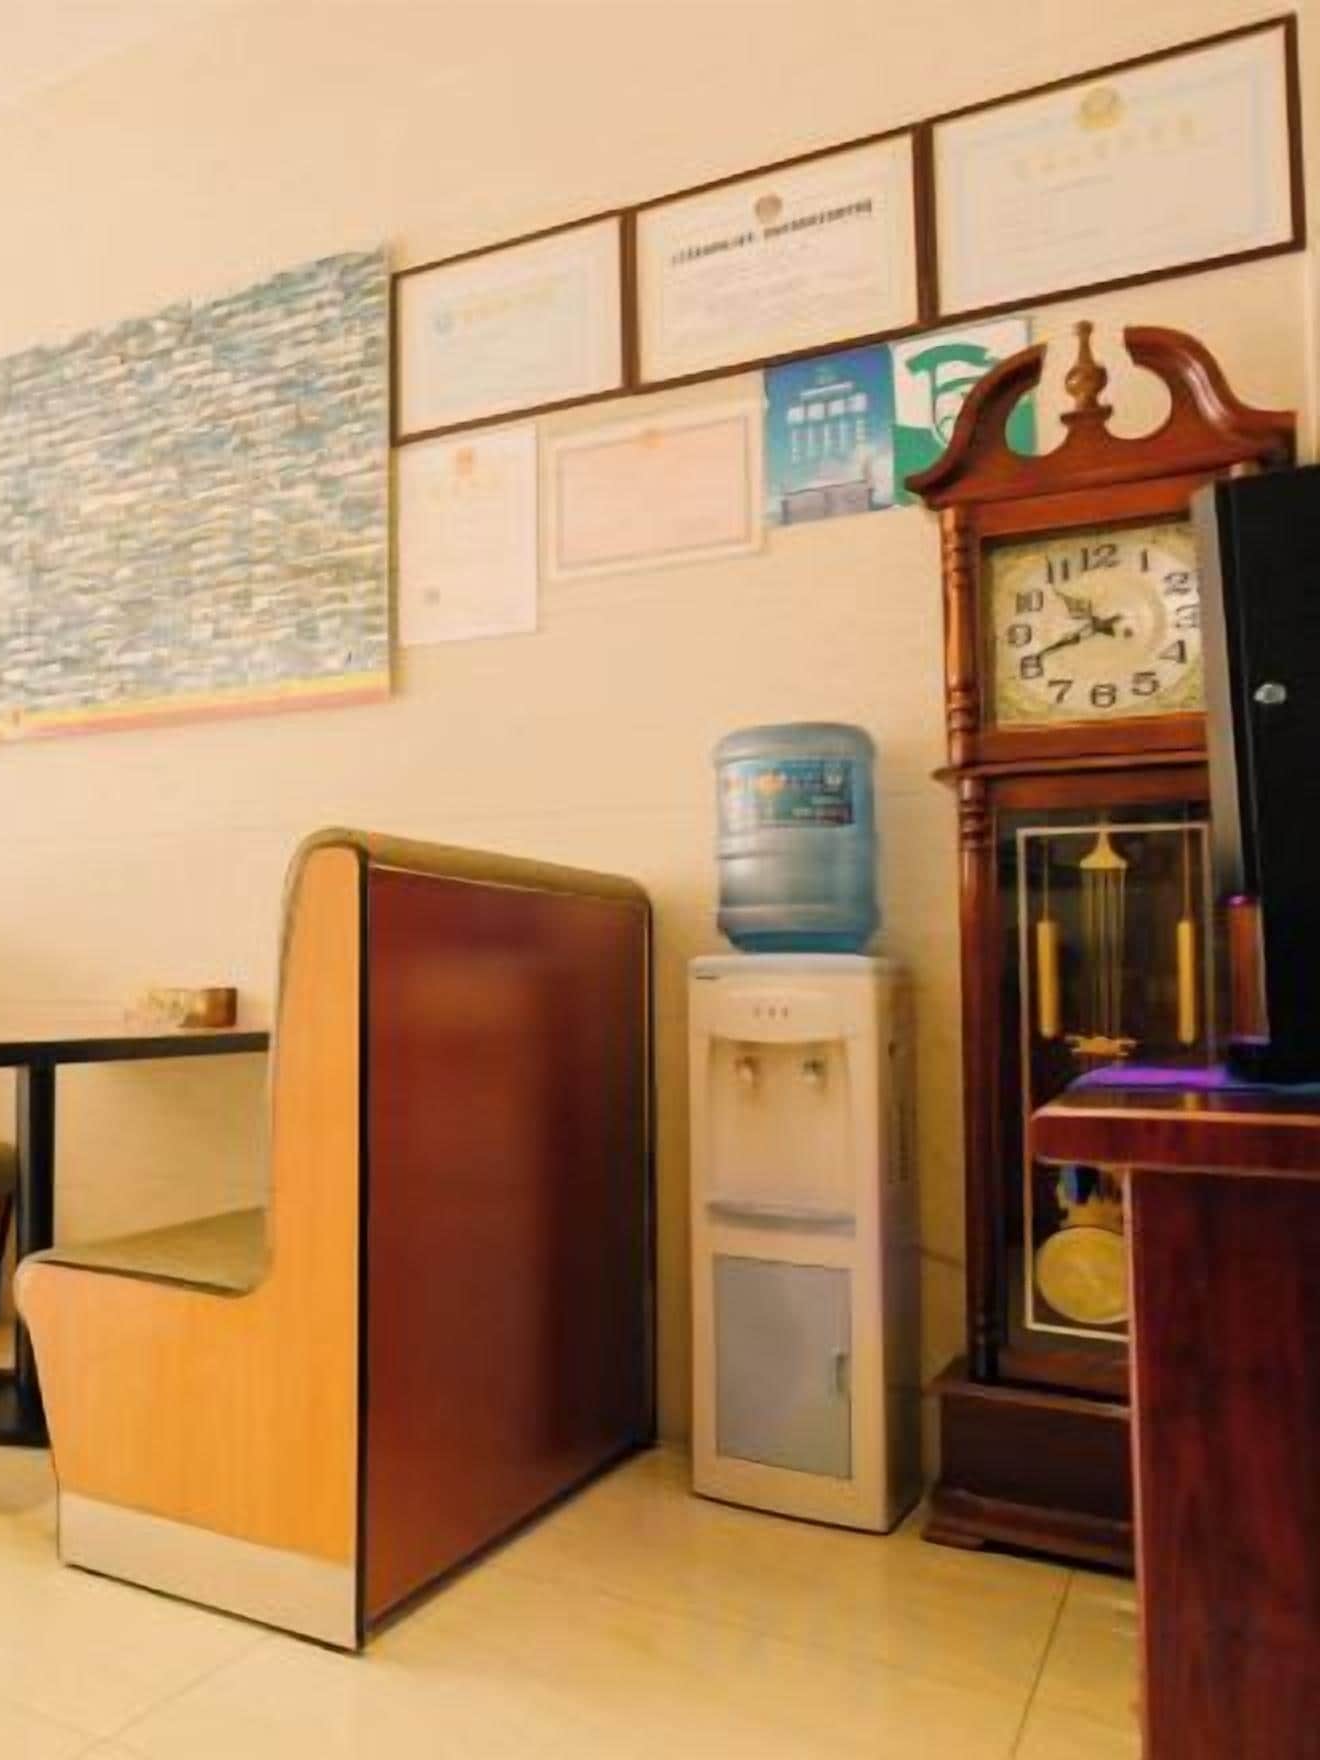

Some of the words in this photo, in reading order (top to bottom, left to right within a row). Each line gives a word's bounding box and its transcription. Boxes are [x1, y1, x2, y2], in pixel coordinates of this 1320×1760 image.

[1081, 544, 1119, 572] 12
[1140, 549, 1149, 573] 1
[1046, 558, 1070, 585] 11
[1164, 572, 1189, 595] 2
[1015, 590, 1045, 614] 10
[1175, 603, 1200, 629] 3
[1007, 623, 1033, 648] 9
[1159, 639, 1188, 664] 4
[1020, 655, 1044, 680] 8
[1047, 679, 1075, 704] 7
[1089, 683, 1118, 709] 6
[1132, 671, 1160, 697] 5
